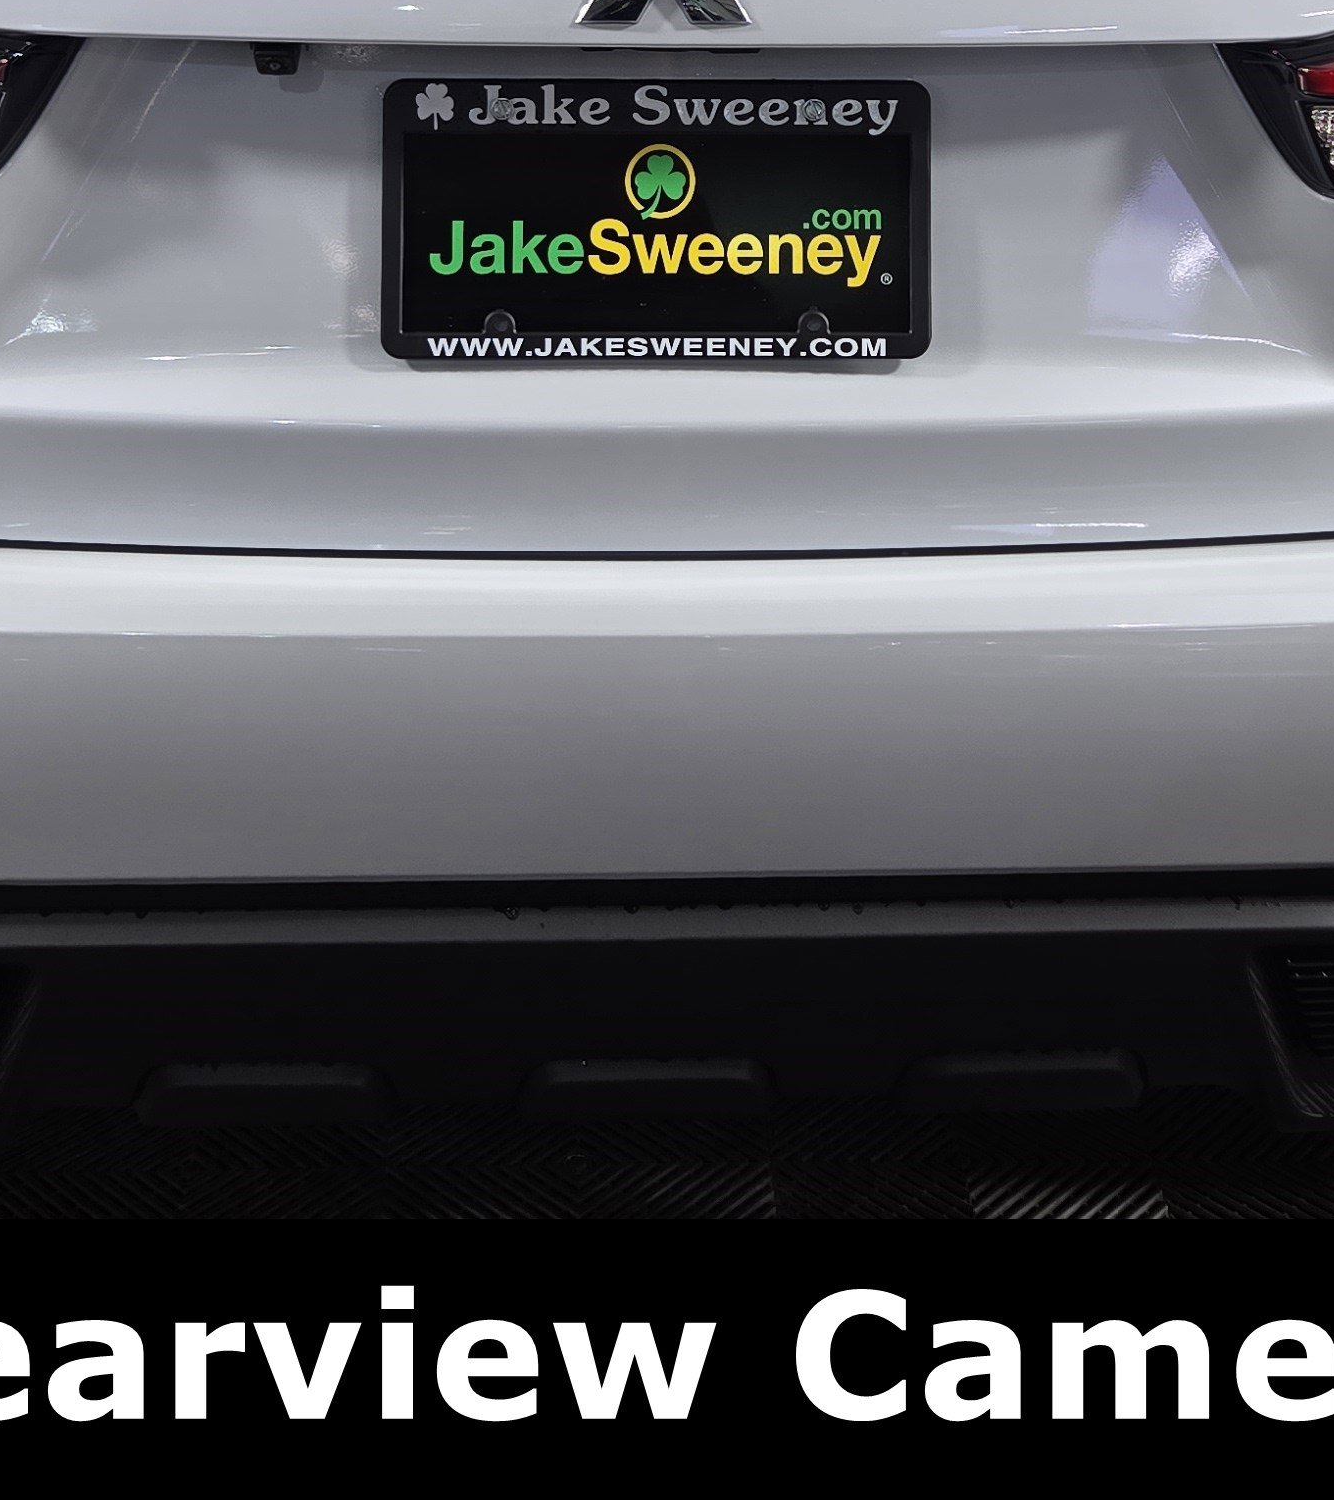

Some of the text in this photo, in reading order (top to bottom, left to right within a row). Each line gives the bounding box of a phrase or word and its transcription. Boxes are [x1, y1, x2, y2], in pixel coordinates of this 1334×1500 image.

[468, 84, 899, 136] Jake Sweeney
[428, 217, 882, 288] JakeSweeney
[427, 336, 888, 358] WWW.JAKESWEENEY.COM
